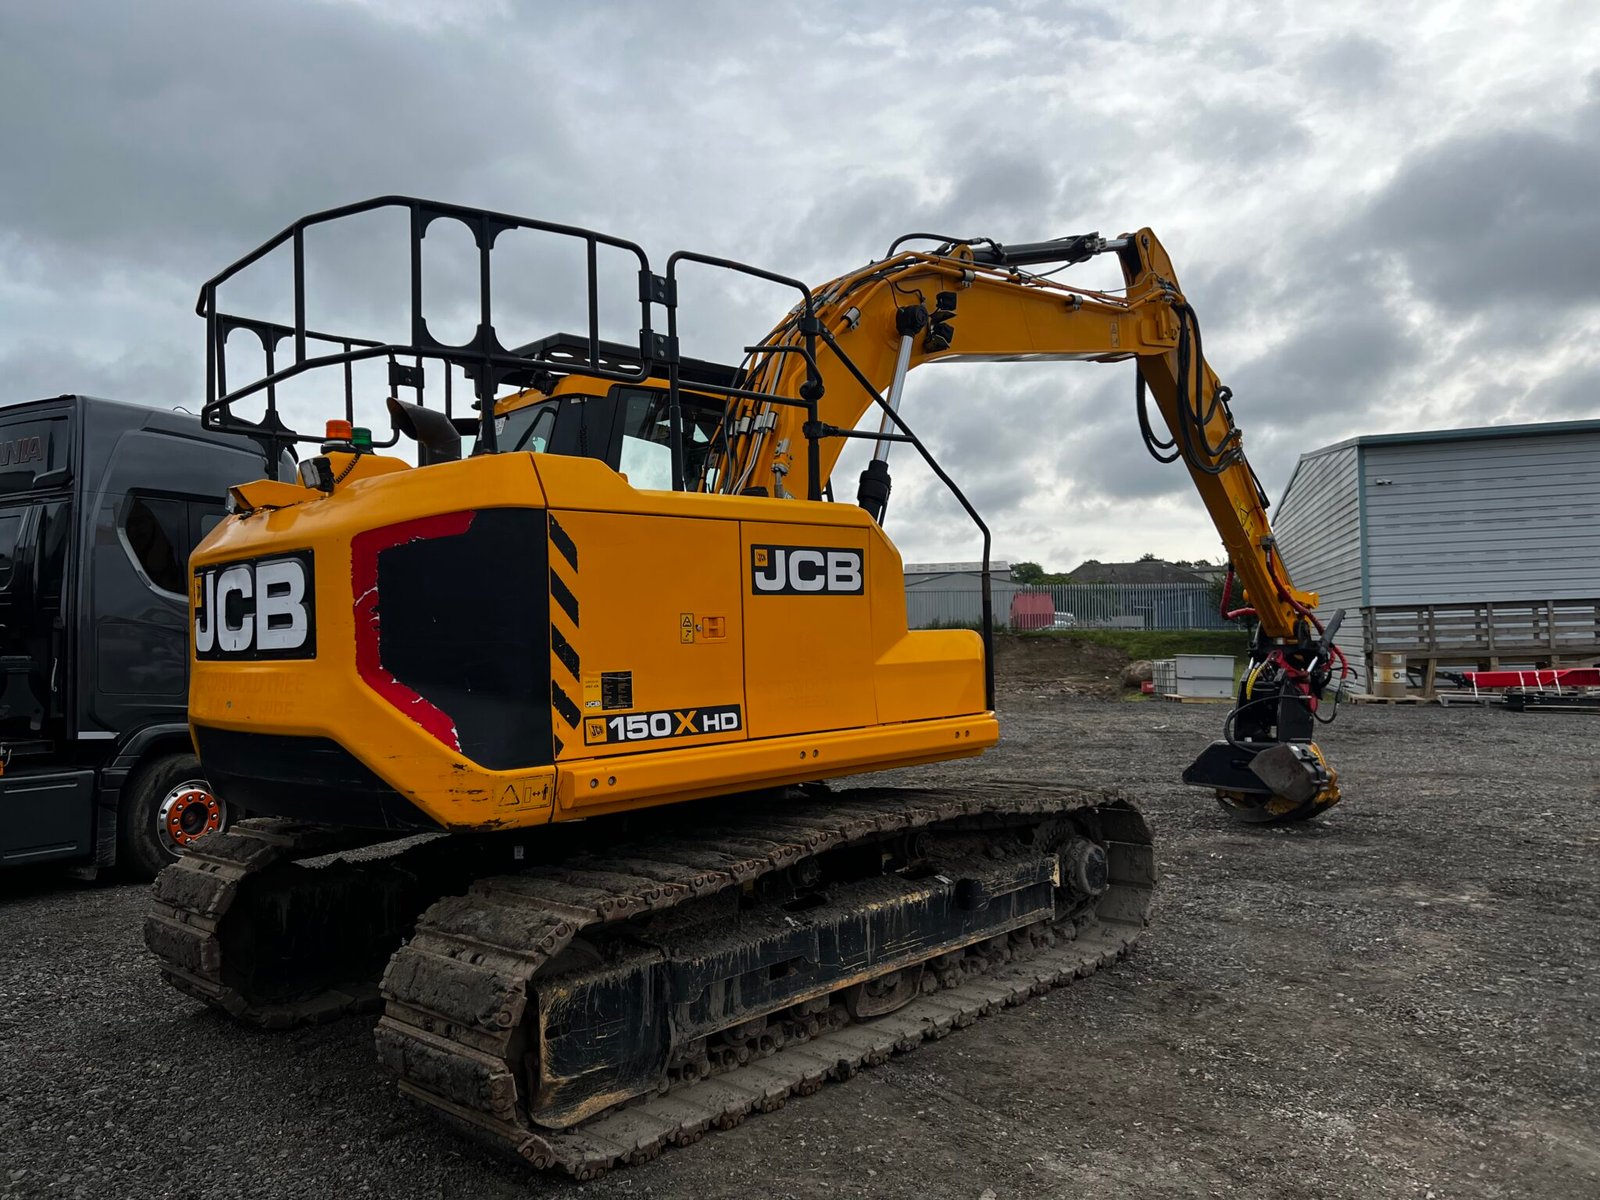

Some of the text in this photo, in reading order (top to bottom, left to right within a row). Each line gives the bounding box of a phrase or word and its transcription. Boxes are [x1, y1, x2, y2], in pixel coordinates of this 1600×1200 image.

[755, 549, 862, 591] JCB
[195, 559, 308, 652] JCB
[703, 712, 738, 732] HD
